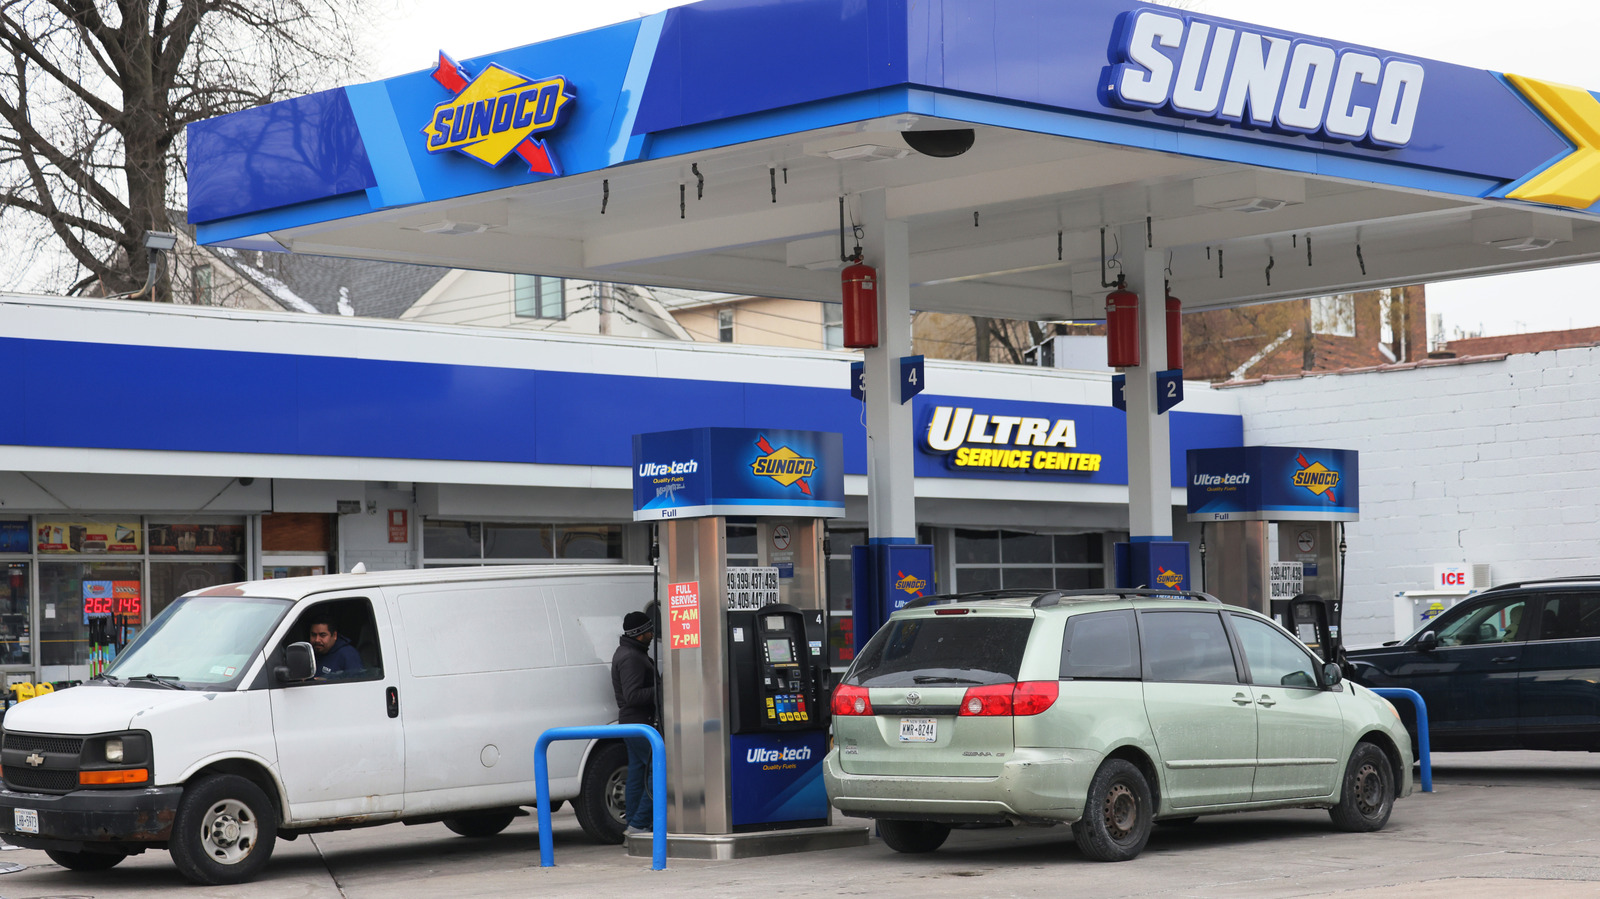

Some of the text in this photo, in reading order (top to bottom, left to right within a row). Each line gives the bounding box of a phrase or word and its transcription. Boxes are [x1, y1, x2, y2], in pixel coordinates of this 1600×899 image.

[1119, 12, 1424, 145] SUNOCO
[430, 83, 560, 148] SUNOCO
[859, 373, 866, 391] 3
[908, 367, 918, 386] 4
[1120, 385, 1126, 401] 1
[1167, 381, 1176, 398] 2
[927, 406, 1077, 451] ULTRA
[755, 458, 812, 475] SUNOCO
[954, 447, 1102, 472] SERVICE CENTER
[1295, 471, 1337, 486] SUNOCO
[662, 509, 677, 518] Full
[736, 573, 748, 589] 399
[751, 573, 762, 589] 437
[897, 581, 925, 589] SUNOCO
[1158, 575, 1182, 583] SUNOCO
[1441, 572, 1465, 585] ICE
[675, 584, 692, 594] FULL
[84, 598, 140, 613] 262 145
[671, 594, 697, 605] SERVICE
[1334, 603, 1339, 611] 2
[671, 609, 698, 621] 7-AM
[816, 614, 822, 624] 4
[673, 633, 699, 646] 7-PM
